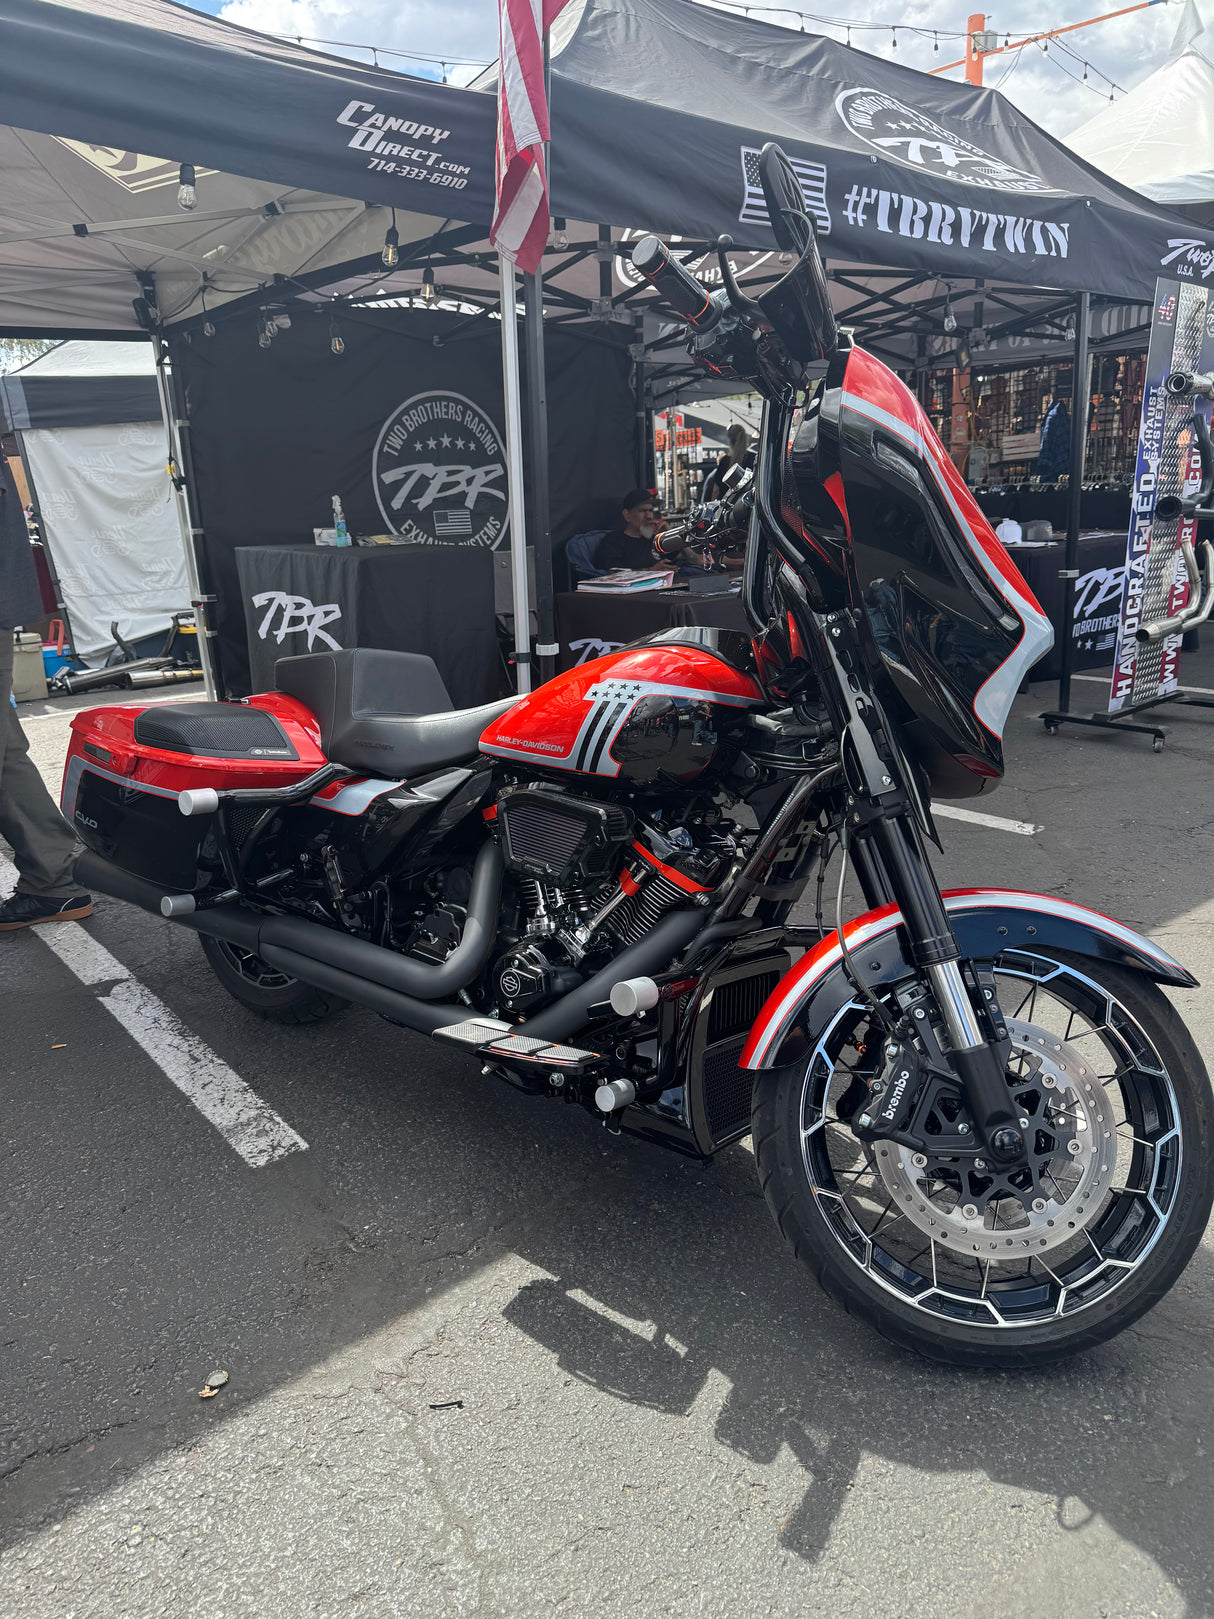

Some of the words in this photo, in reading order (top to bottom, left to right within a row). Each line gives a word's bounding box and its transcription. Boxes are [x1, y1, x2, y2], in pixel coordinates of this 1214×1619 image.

[336, 99, 451, 144] CANOPY
[367, 157, 468, 190] 714-333-6910
[842, 184, 1070, 259] #TBRVTWIN
[1176, 263, 1194, 277] U.S.A.
[383, 425, 408, 456] TWO
[402, 401, 464, 432] BROTHERS
[463, 410, 498, 456] RACING
[1143, 386, 1158, 460] EXHAUST
[1151, 386, 1166, 460] SYSTEMS
[379, 462, 506, 512] TBR
[1116, 472, 1157, 699] HANDCRAFTED
[251, 590, 344, 653] TBR
[496, 734, 565, 753] HARLEY-DAVIDSON
[75, 809, 99, 829] CVO
[881, 1070, 910, 1120] brembo
